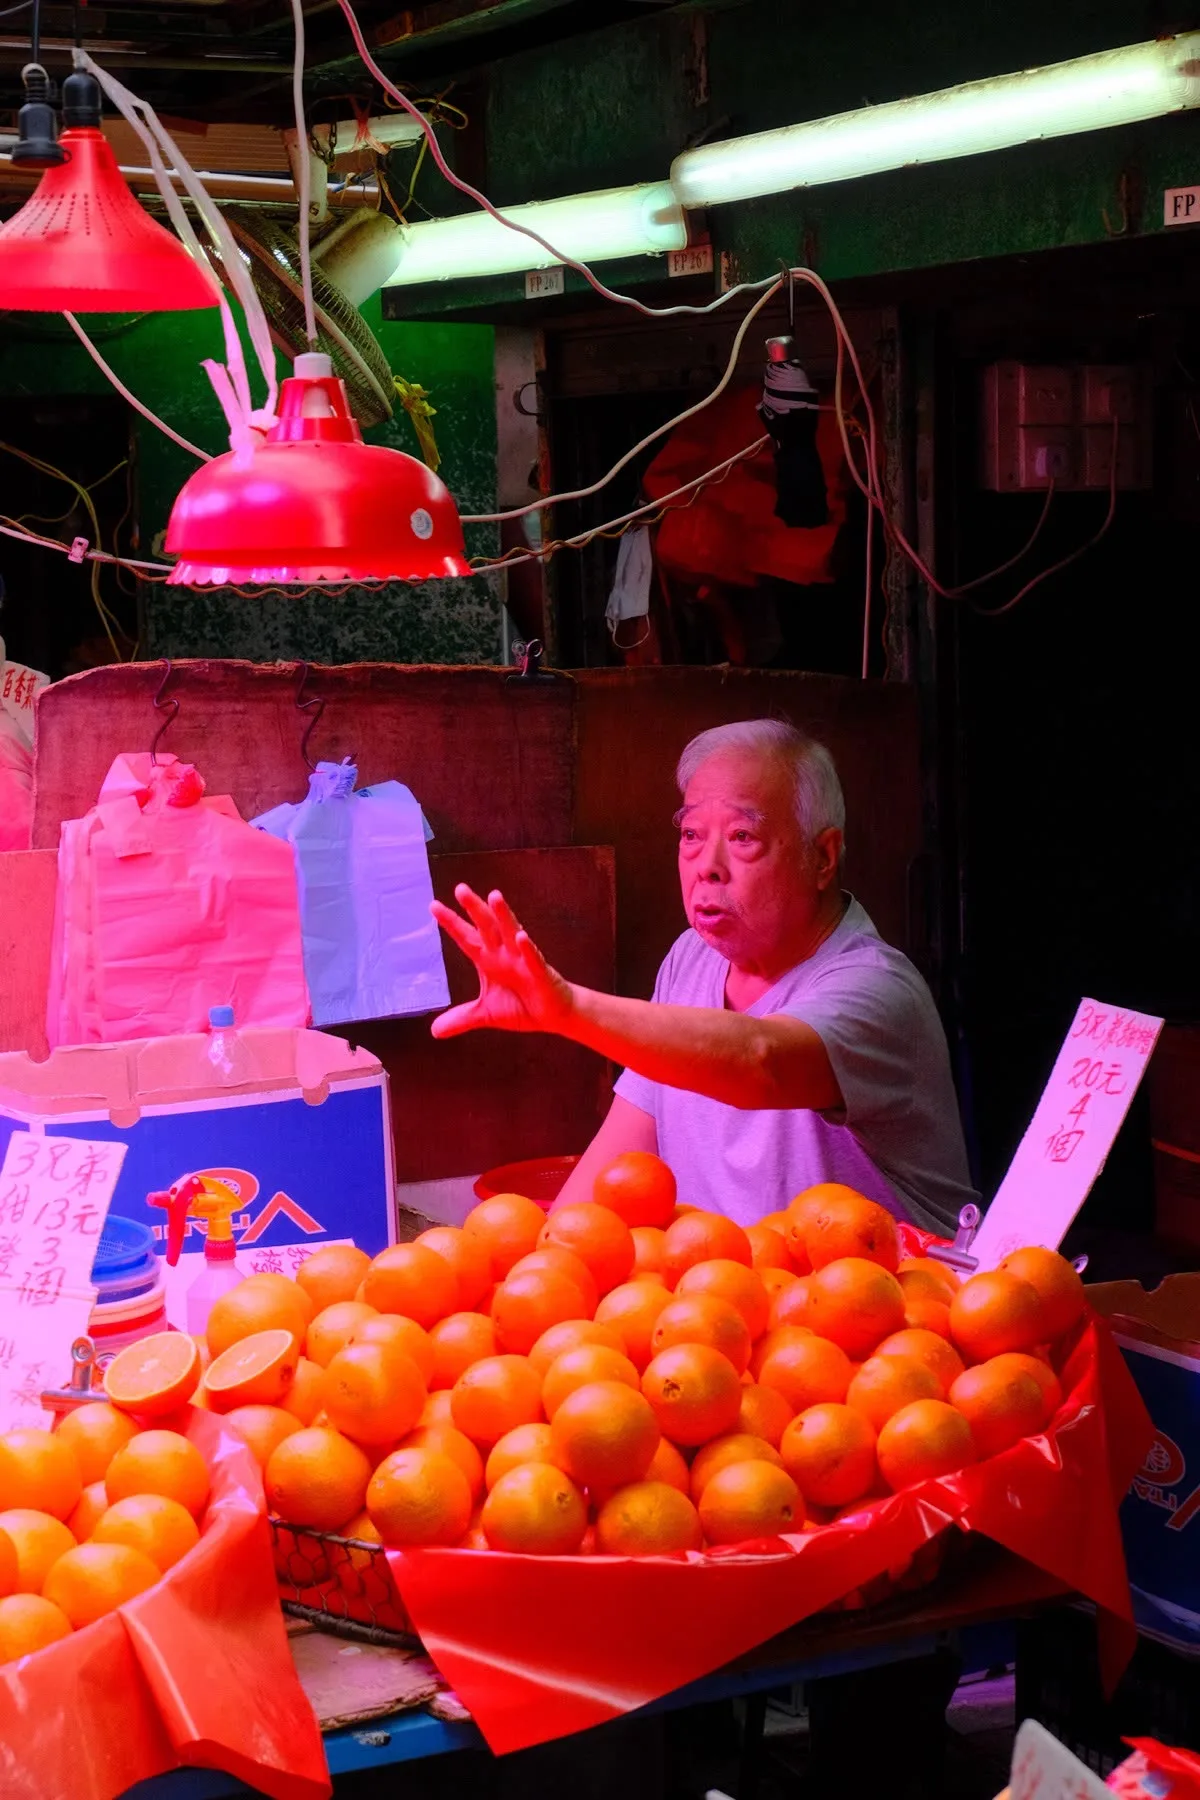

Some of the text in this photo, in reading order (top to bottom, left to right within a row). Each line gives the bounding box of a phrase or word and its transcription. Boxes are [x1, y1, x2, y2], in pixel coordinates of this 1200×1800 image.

[1172, 194, 1196, 218] FP
[674, 253, 688, 272] FP
[529, 276, 542, 293] FP
[1067, 1057, 1128, 1095] 20元
[1068, 1092, 1092, 1128] 4
[8, 1141, 111, 1197] 3兄弟
[33, 1197, 100, 1235] 13元
[33, 1236, 61, 1267] 3
